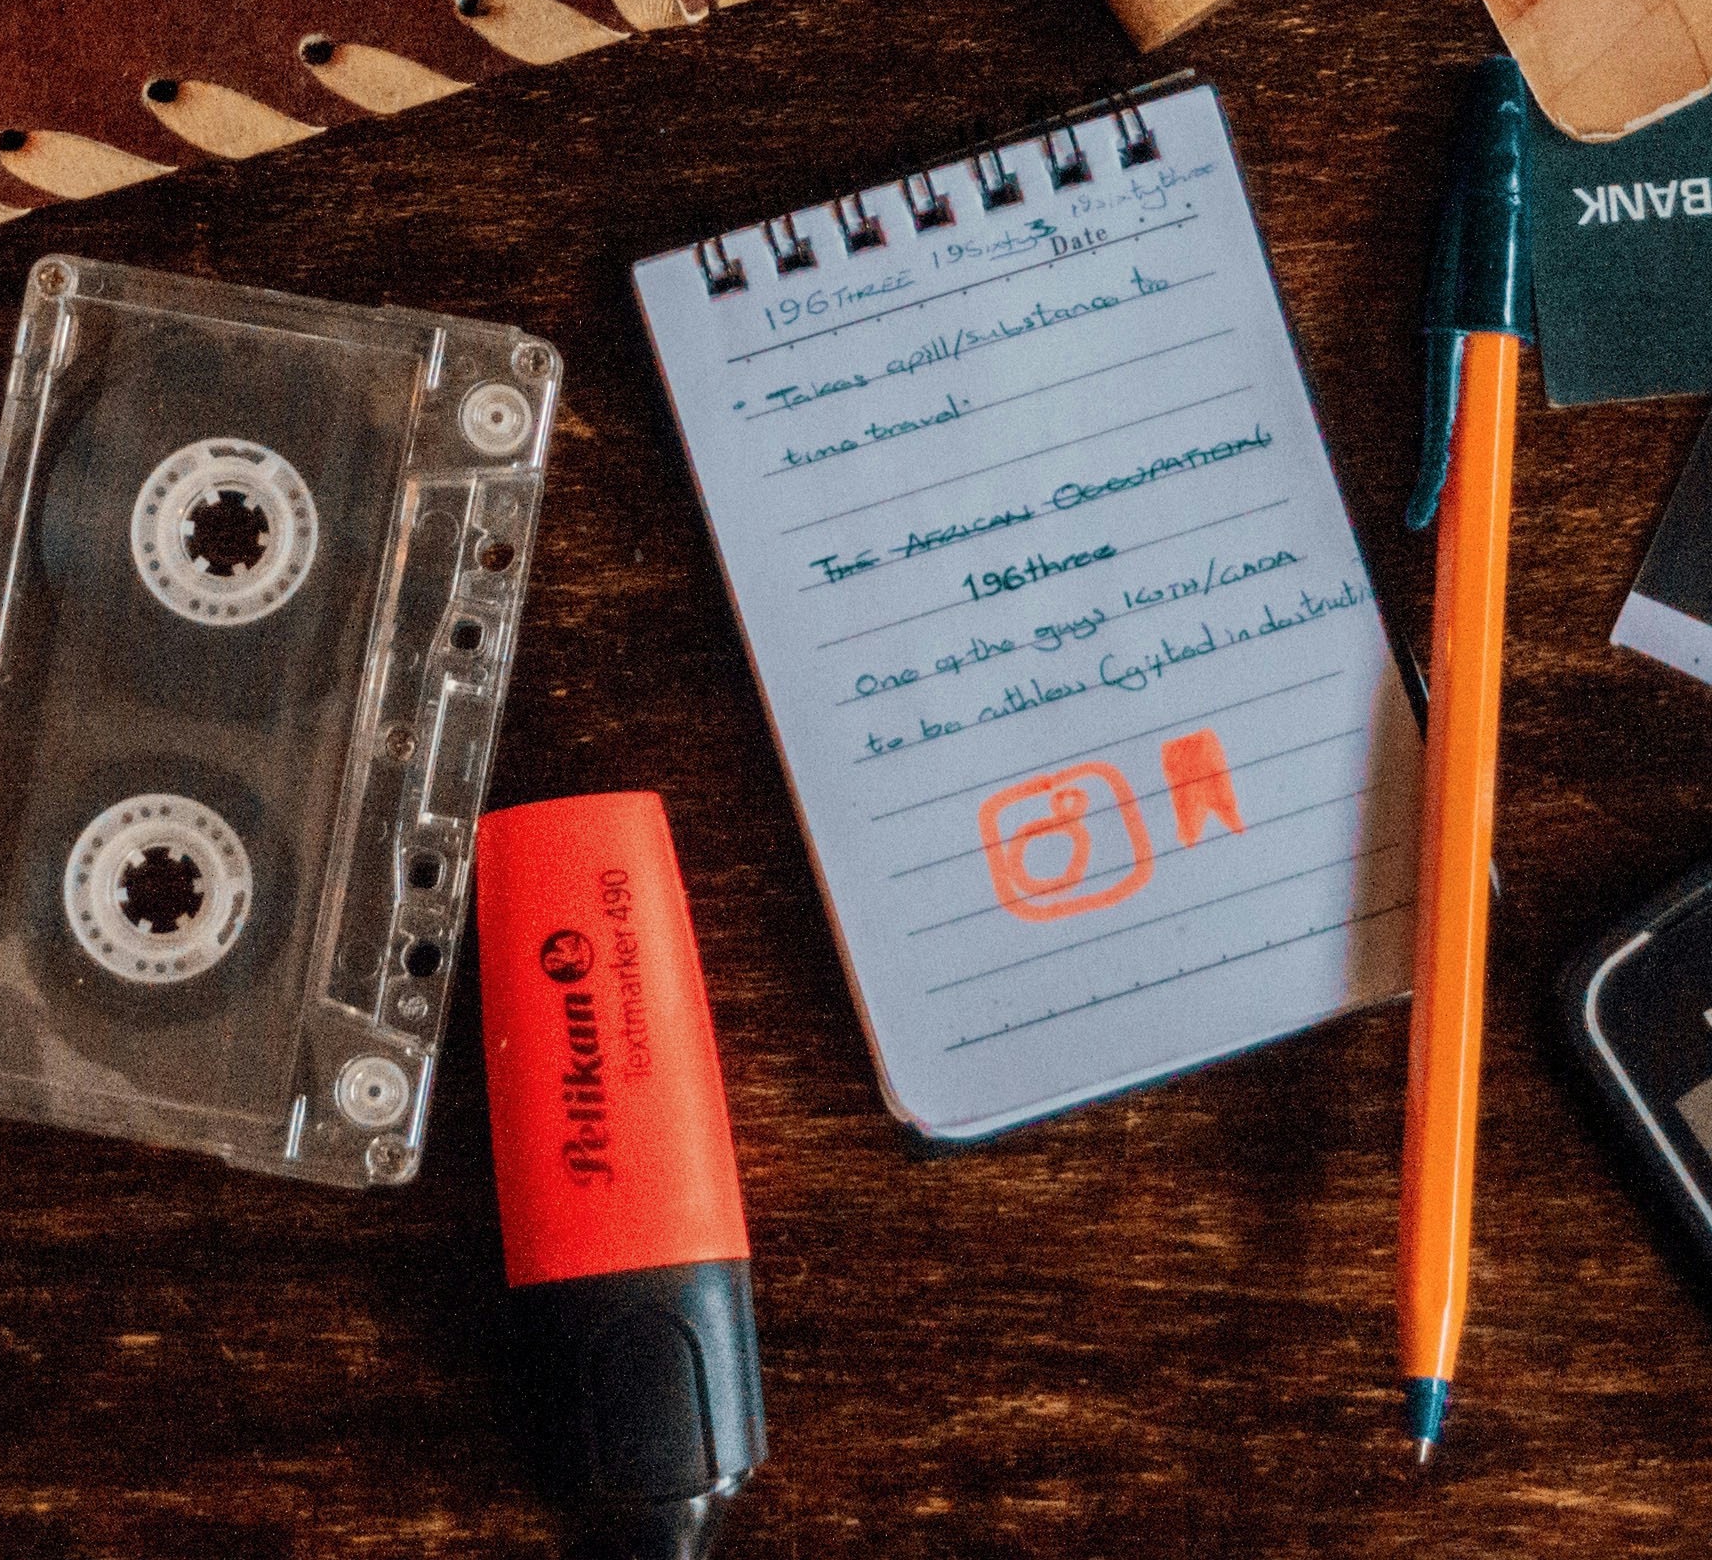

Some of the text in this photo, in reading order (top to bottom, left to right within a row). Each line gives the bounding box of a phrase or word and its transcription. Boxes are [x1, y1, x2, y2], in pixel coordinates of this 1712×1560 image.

[1573, 178, 1710, 228] BANK
[1051, 224, 1109, 258] Date
[784, 430, 860, 469] time
[962, 540, 1118, 603] 196three
[855, 666, 919, 698] One
[1034, 607, 1106, 654] guys
[600, 868, 652, 1085] Textmarker 490
[562, 991, 615, 1188] Pelikan
